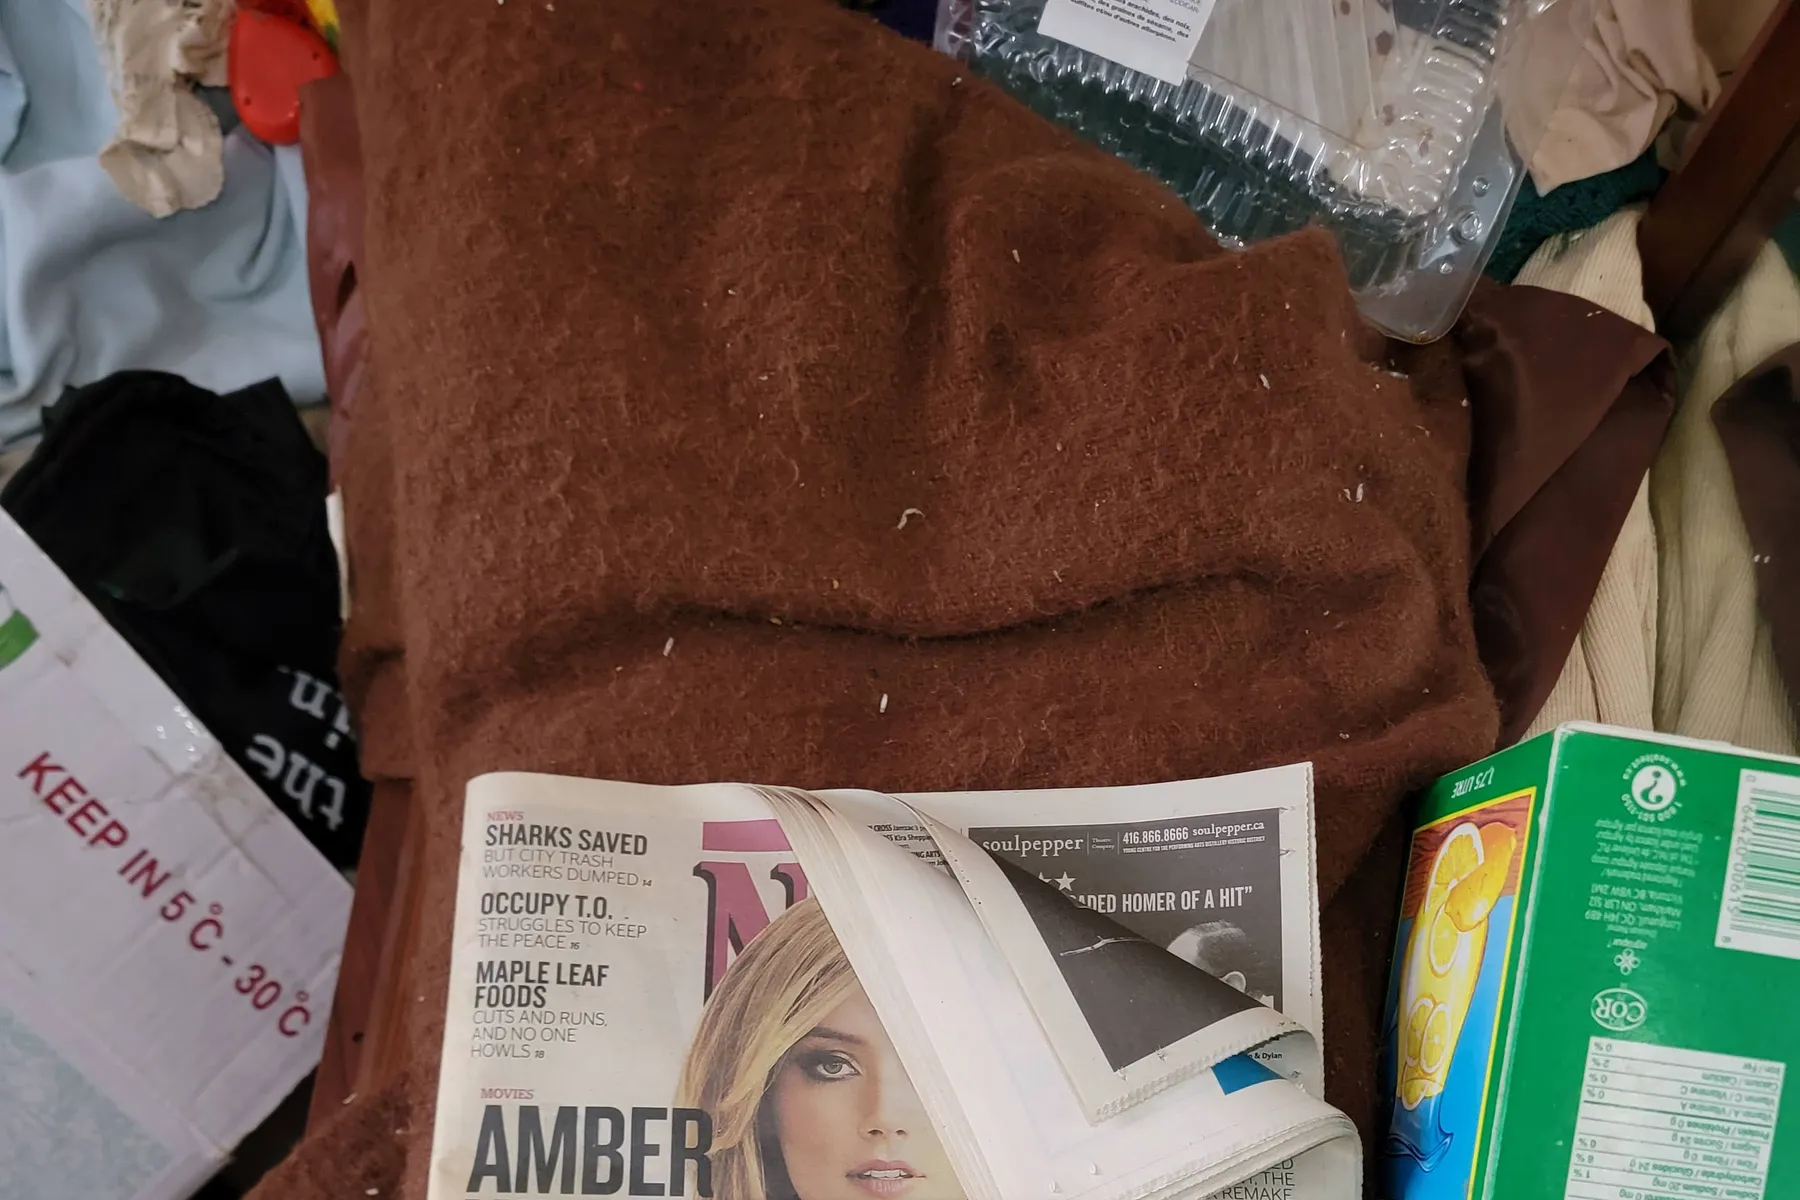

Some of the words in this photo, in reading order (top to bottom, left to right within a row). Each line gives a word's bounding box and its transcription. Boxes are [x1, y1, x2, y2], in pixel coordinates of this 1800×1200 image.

[245, 732, 346, 832] the
[487, 811, 524, 822] NEWS
[485, 823, 572, 849] SHARKS
[578, 829, 648, 856] SAVED
[1123, 827, 1189, 844] 416.866.8666
[1192, 821, 1265, 838] soulpepper.ca
[982, 834, 1084, 857] soulpepper
[484, 849, 514, 863] BUT
[519, 849, 558, 863] CITY
[560, 851, 613, 868] TRASH
[15, 751, 129, 849] KEEP
[117, 848, 172, 899] IN
[159, 889, 196, 922] 5
[233, 963, 282, 1012] 30
[482, 864, 563, 880] WORKERS
[567, 867, 639, 886] DUMPED
[480, 892, 570, 916] OCCUPY
[575, 895, 613, 920] T.O.
[1122, 892, 1176, 913] HOMER
[1180, 890, 1200, 910] OF
[1204, 889, 1215, 909] A
[478, 917, 574, 934] STRUGGLES
[579, 920, 602, 936] TO
[605, 924, 648, 939] KEEP
[478, 934, 509, 948] THE
[513, 934, 566, 949] PEACE
[475, 960, 550, 984] MAPLE
[555, 962, 610, 987] LEAF
[474, 985, 547, 1008] FOODS
[472, 1009, 516, 1025] CUTS
[518, 1010, 556, 1025] AND
[560, 1012, 608, 1027] RUNS,
[1595, 998, 1645, 1022] COR
[472, 1027, 507, 1042] AND
[511, 1027, 537, 1042] NO
[540, 1027, 577, 1043] ONE
[470, 1043, 531, 1059] HOWLS
[1262, 1052, 1282, 1060] Dylan
[480, 1088, 534, 1100] MOVIES
[466, 1105, 714, 1198] AMBER
[1262, 1171, 1295, 1187] THE
